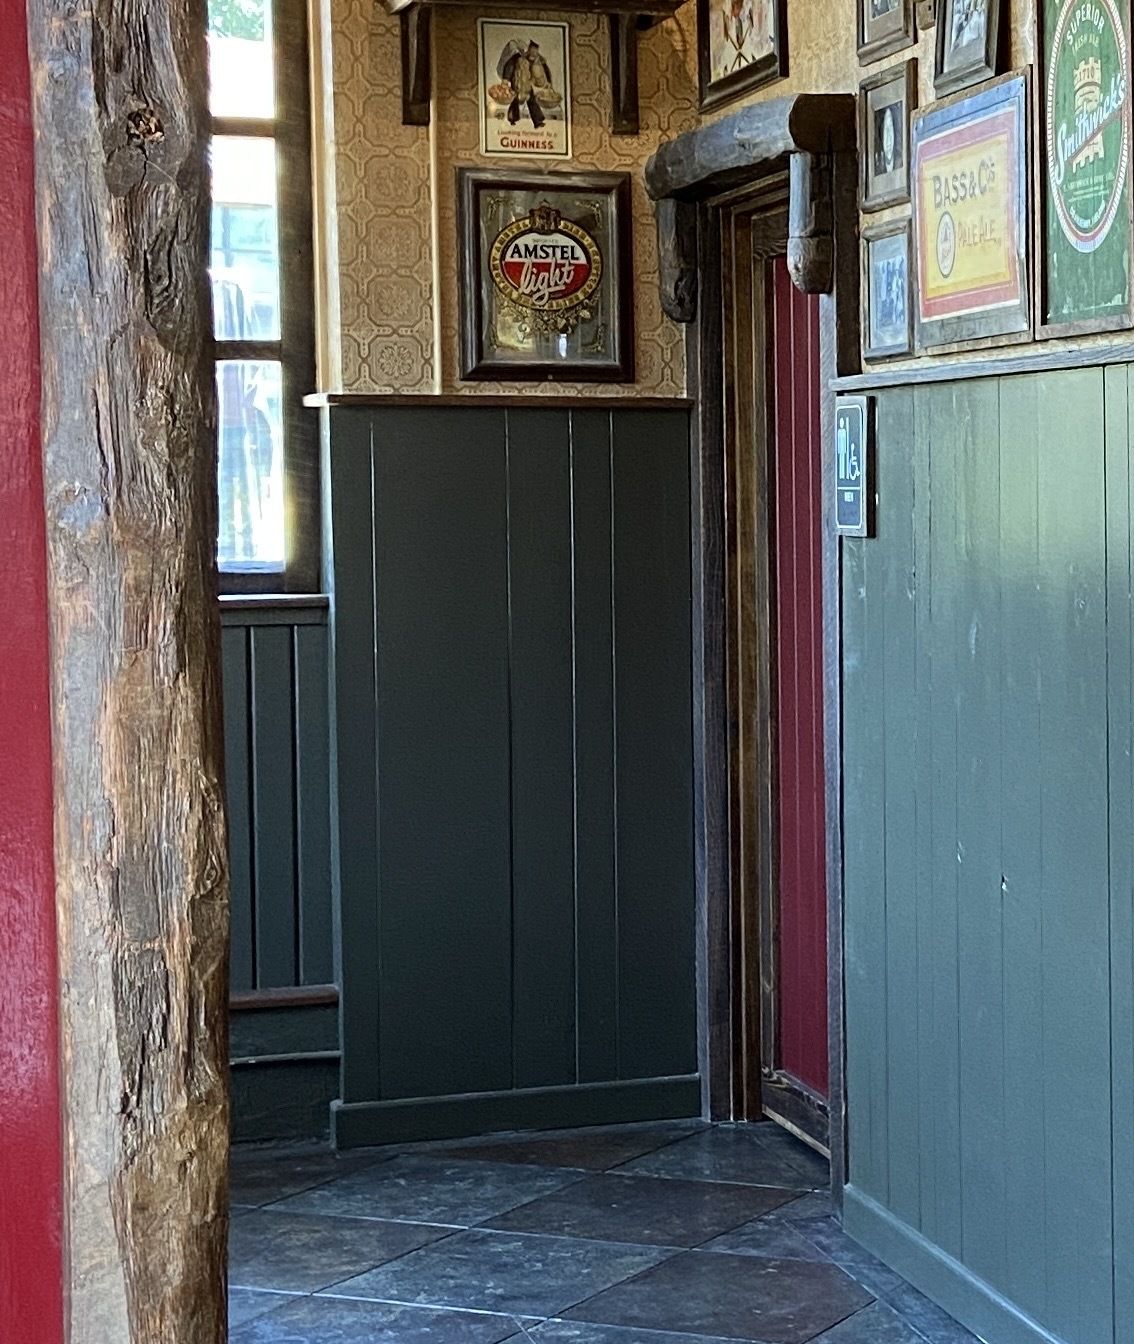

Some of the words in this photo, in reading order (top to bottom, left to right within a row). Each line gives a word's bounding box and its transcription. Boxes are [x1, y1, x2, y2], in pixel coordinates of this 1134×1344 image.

[1067, 3, 1105, 46] SUPERIOR
[500, 136, 554, 149] GUINNESS
[1054, 73, 1125, 185] Smithwick's
[510, 243, 579, 260] AMSTEL
[519, 258, 575, 305] light
